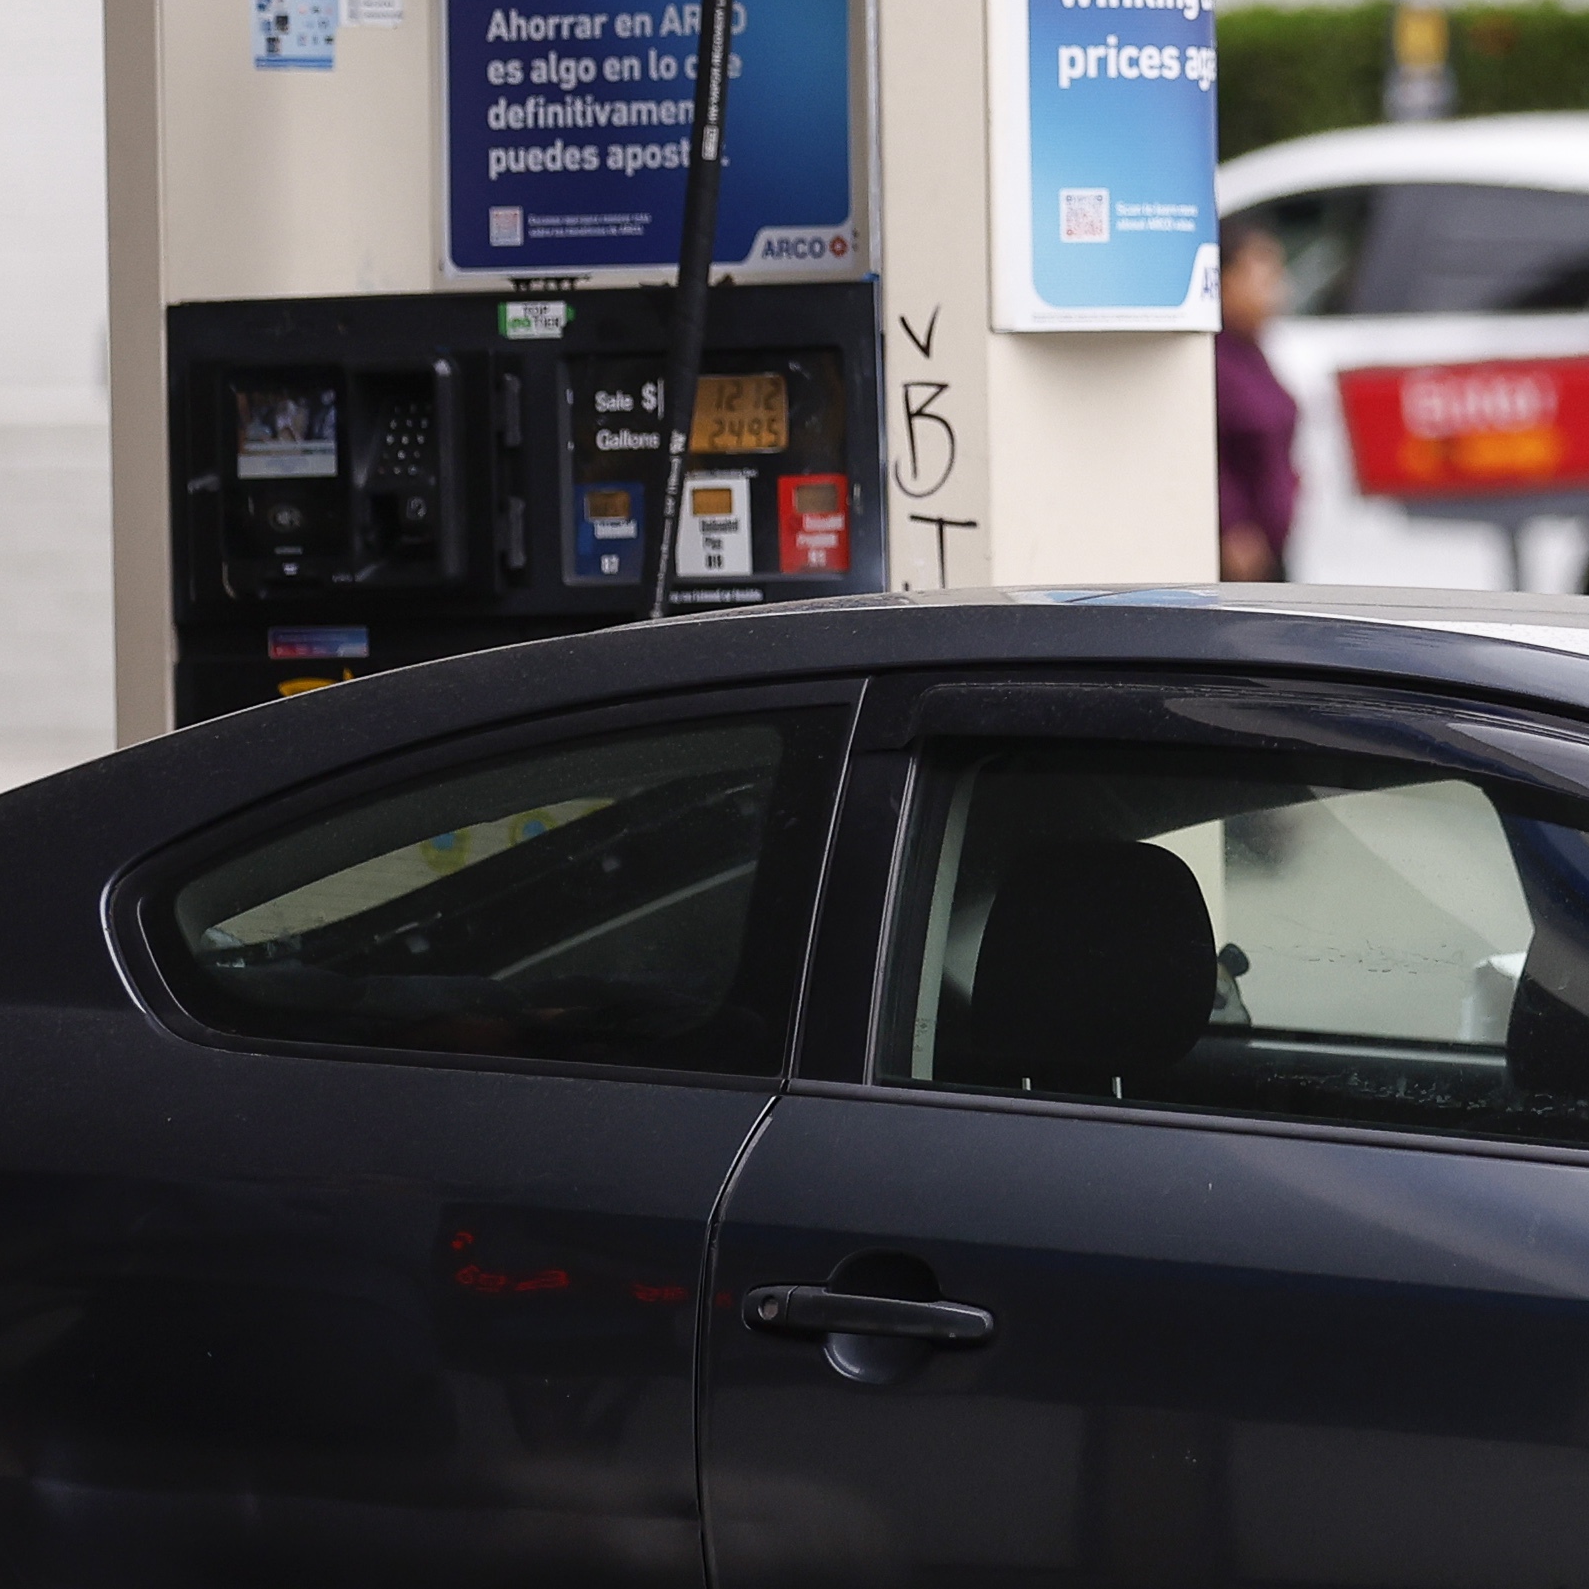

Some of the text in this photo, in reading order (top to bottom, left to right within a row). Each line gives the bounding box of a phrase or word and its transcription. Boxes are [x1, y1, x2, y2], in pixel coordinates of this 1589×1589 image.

[486, 1, 748, 42] Ahorrar en ARO
[486, 59, 524, 85] es
[529, 49, 597, 91] algo
[602, 55, 642, 82] en
[648, 47, 678, 81] lo
[1058, 34, 1181, 89] prices
[487, 94, 696, 130] definitivamen
[488, 138, 600, 180] puedes
[761, 236, 826, 260] ARCO
[594, 381, 658, 413] Sale $
[595, 428, 660, 451] Gallons
